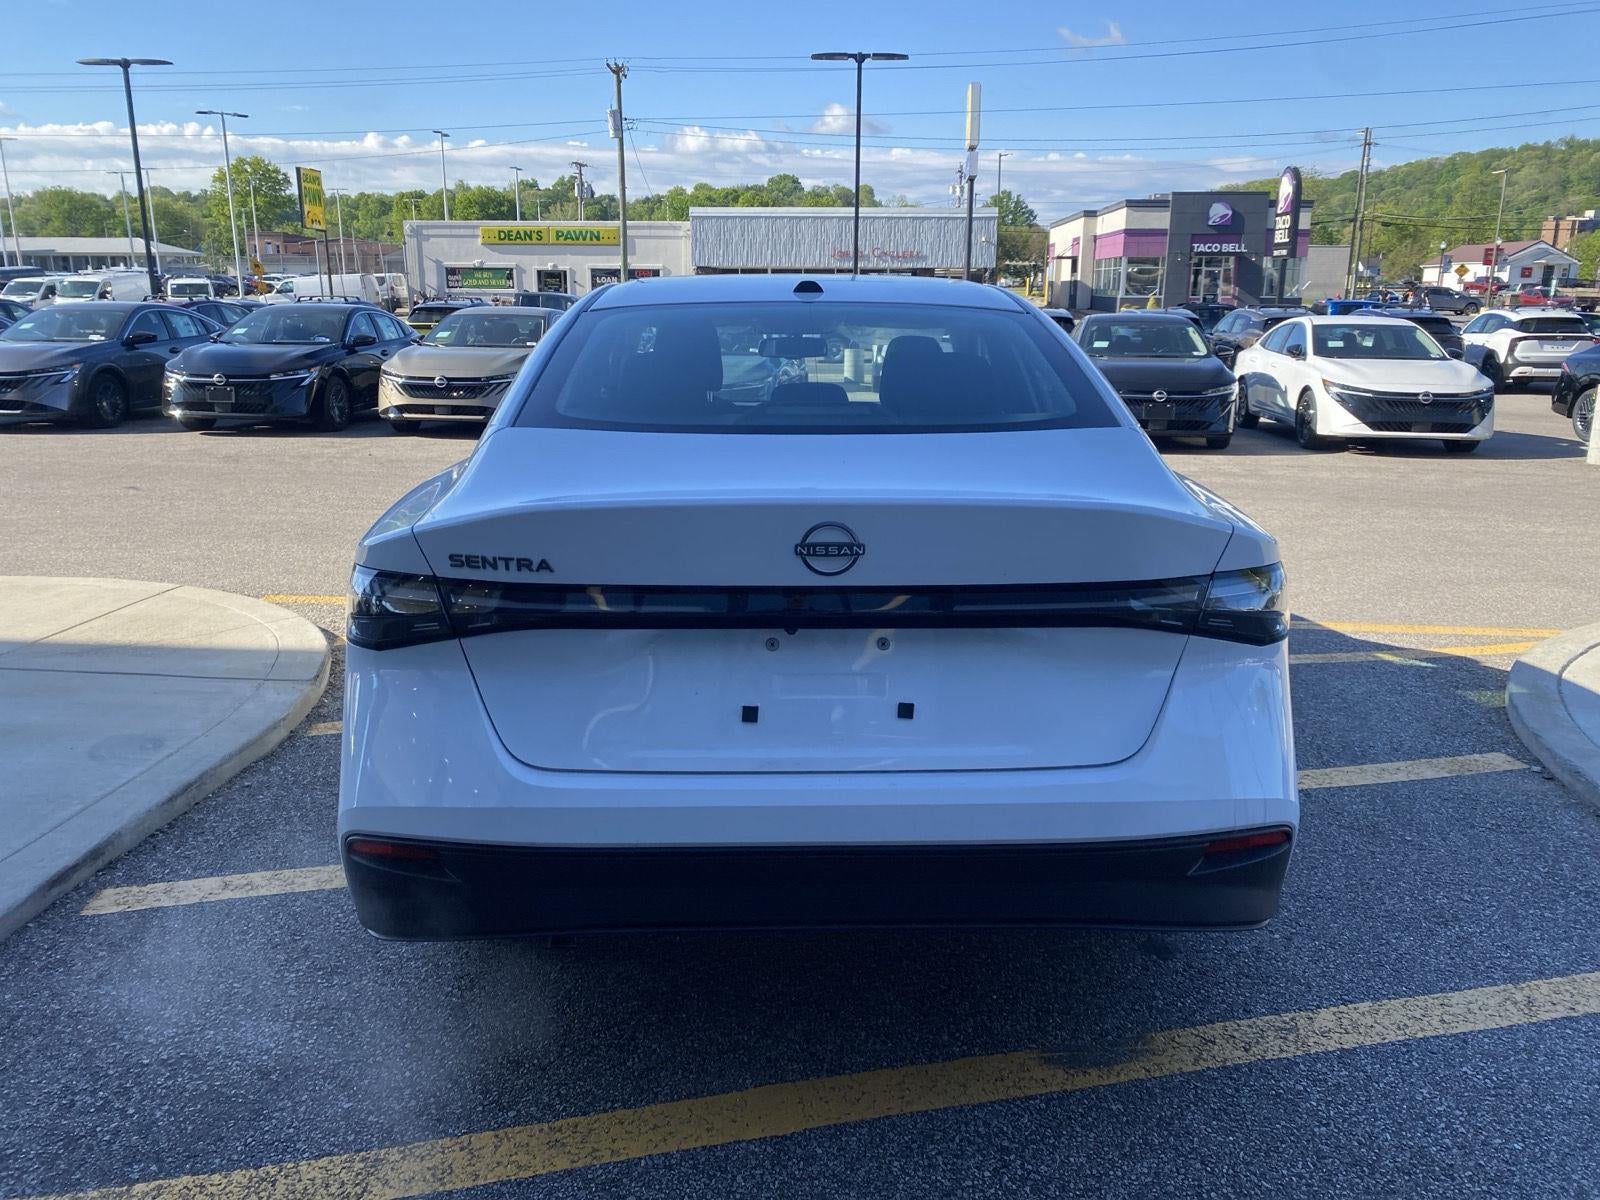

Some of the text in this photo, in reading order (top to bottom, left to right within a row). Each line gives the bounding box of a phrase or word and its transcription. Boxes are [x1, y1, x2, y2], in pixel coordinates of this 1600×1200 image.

[1275, 214, 1291, 230] TACO
[497, 230, 601, 242] DEAN'S PAWN
[1274, 229, 1290, 243] BELL
[1192, 243, 1248, 252] TACO BELL
[797, 546, 864, 555] NISSAN
[448, 553, 555, 573] SENTRA
